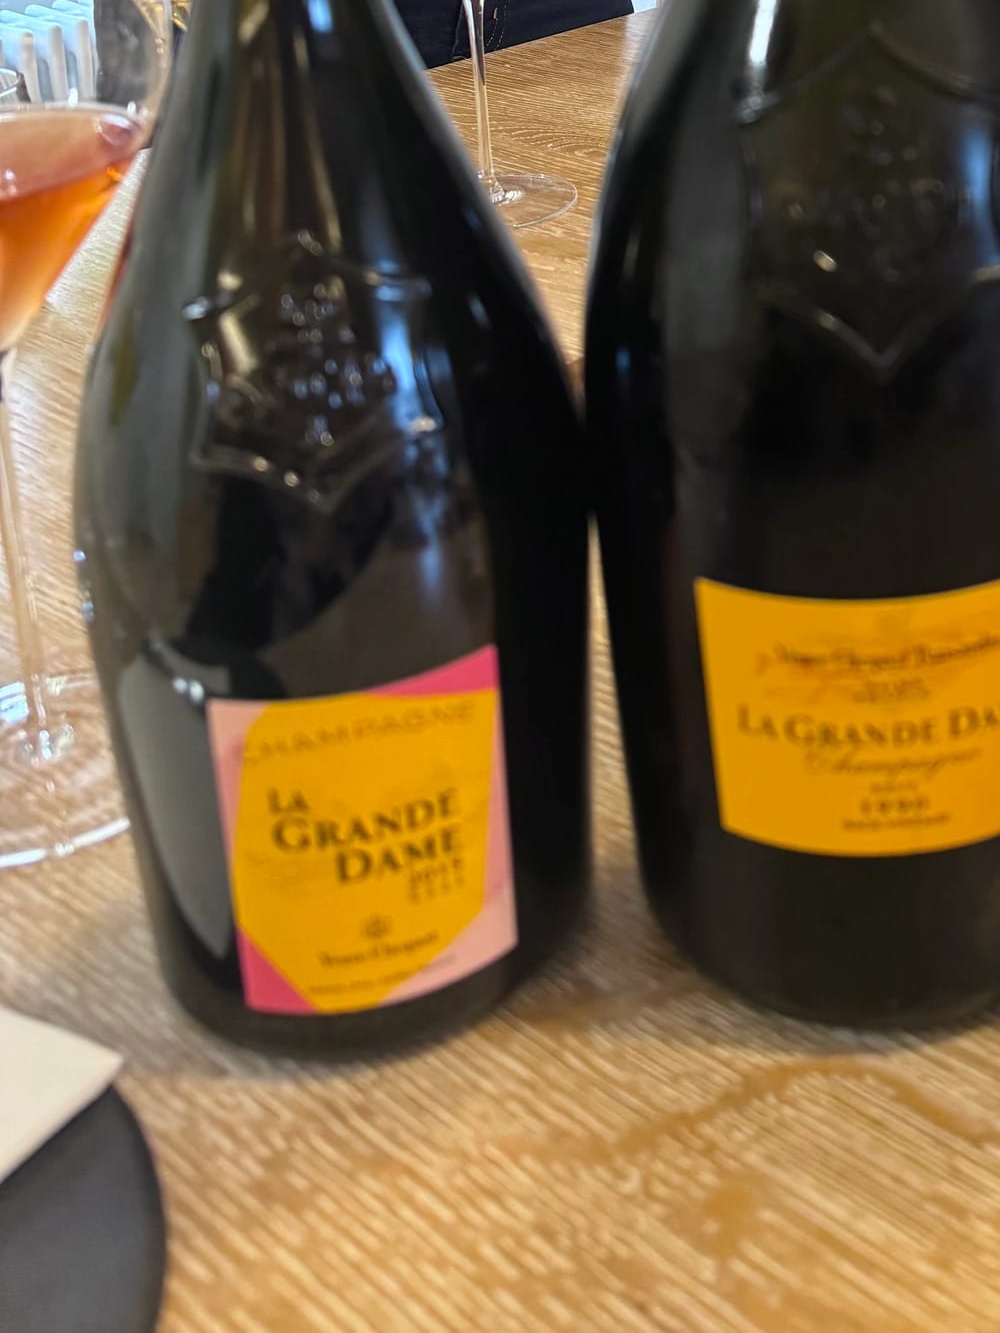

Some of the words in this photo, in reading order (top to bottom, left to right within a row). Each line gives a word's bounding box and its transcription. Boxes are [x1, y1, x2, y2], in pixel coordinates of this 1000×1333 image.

[737, 703, 779, 739] LA
[782, 711, 938, 749] GRANDE
[266, 787, 311, 816] LA
[271, 788, 459, 852] GRANDE
[338, 826, 461, 884] DAME
